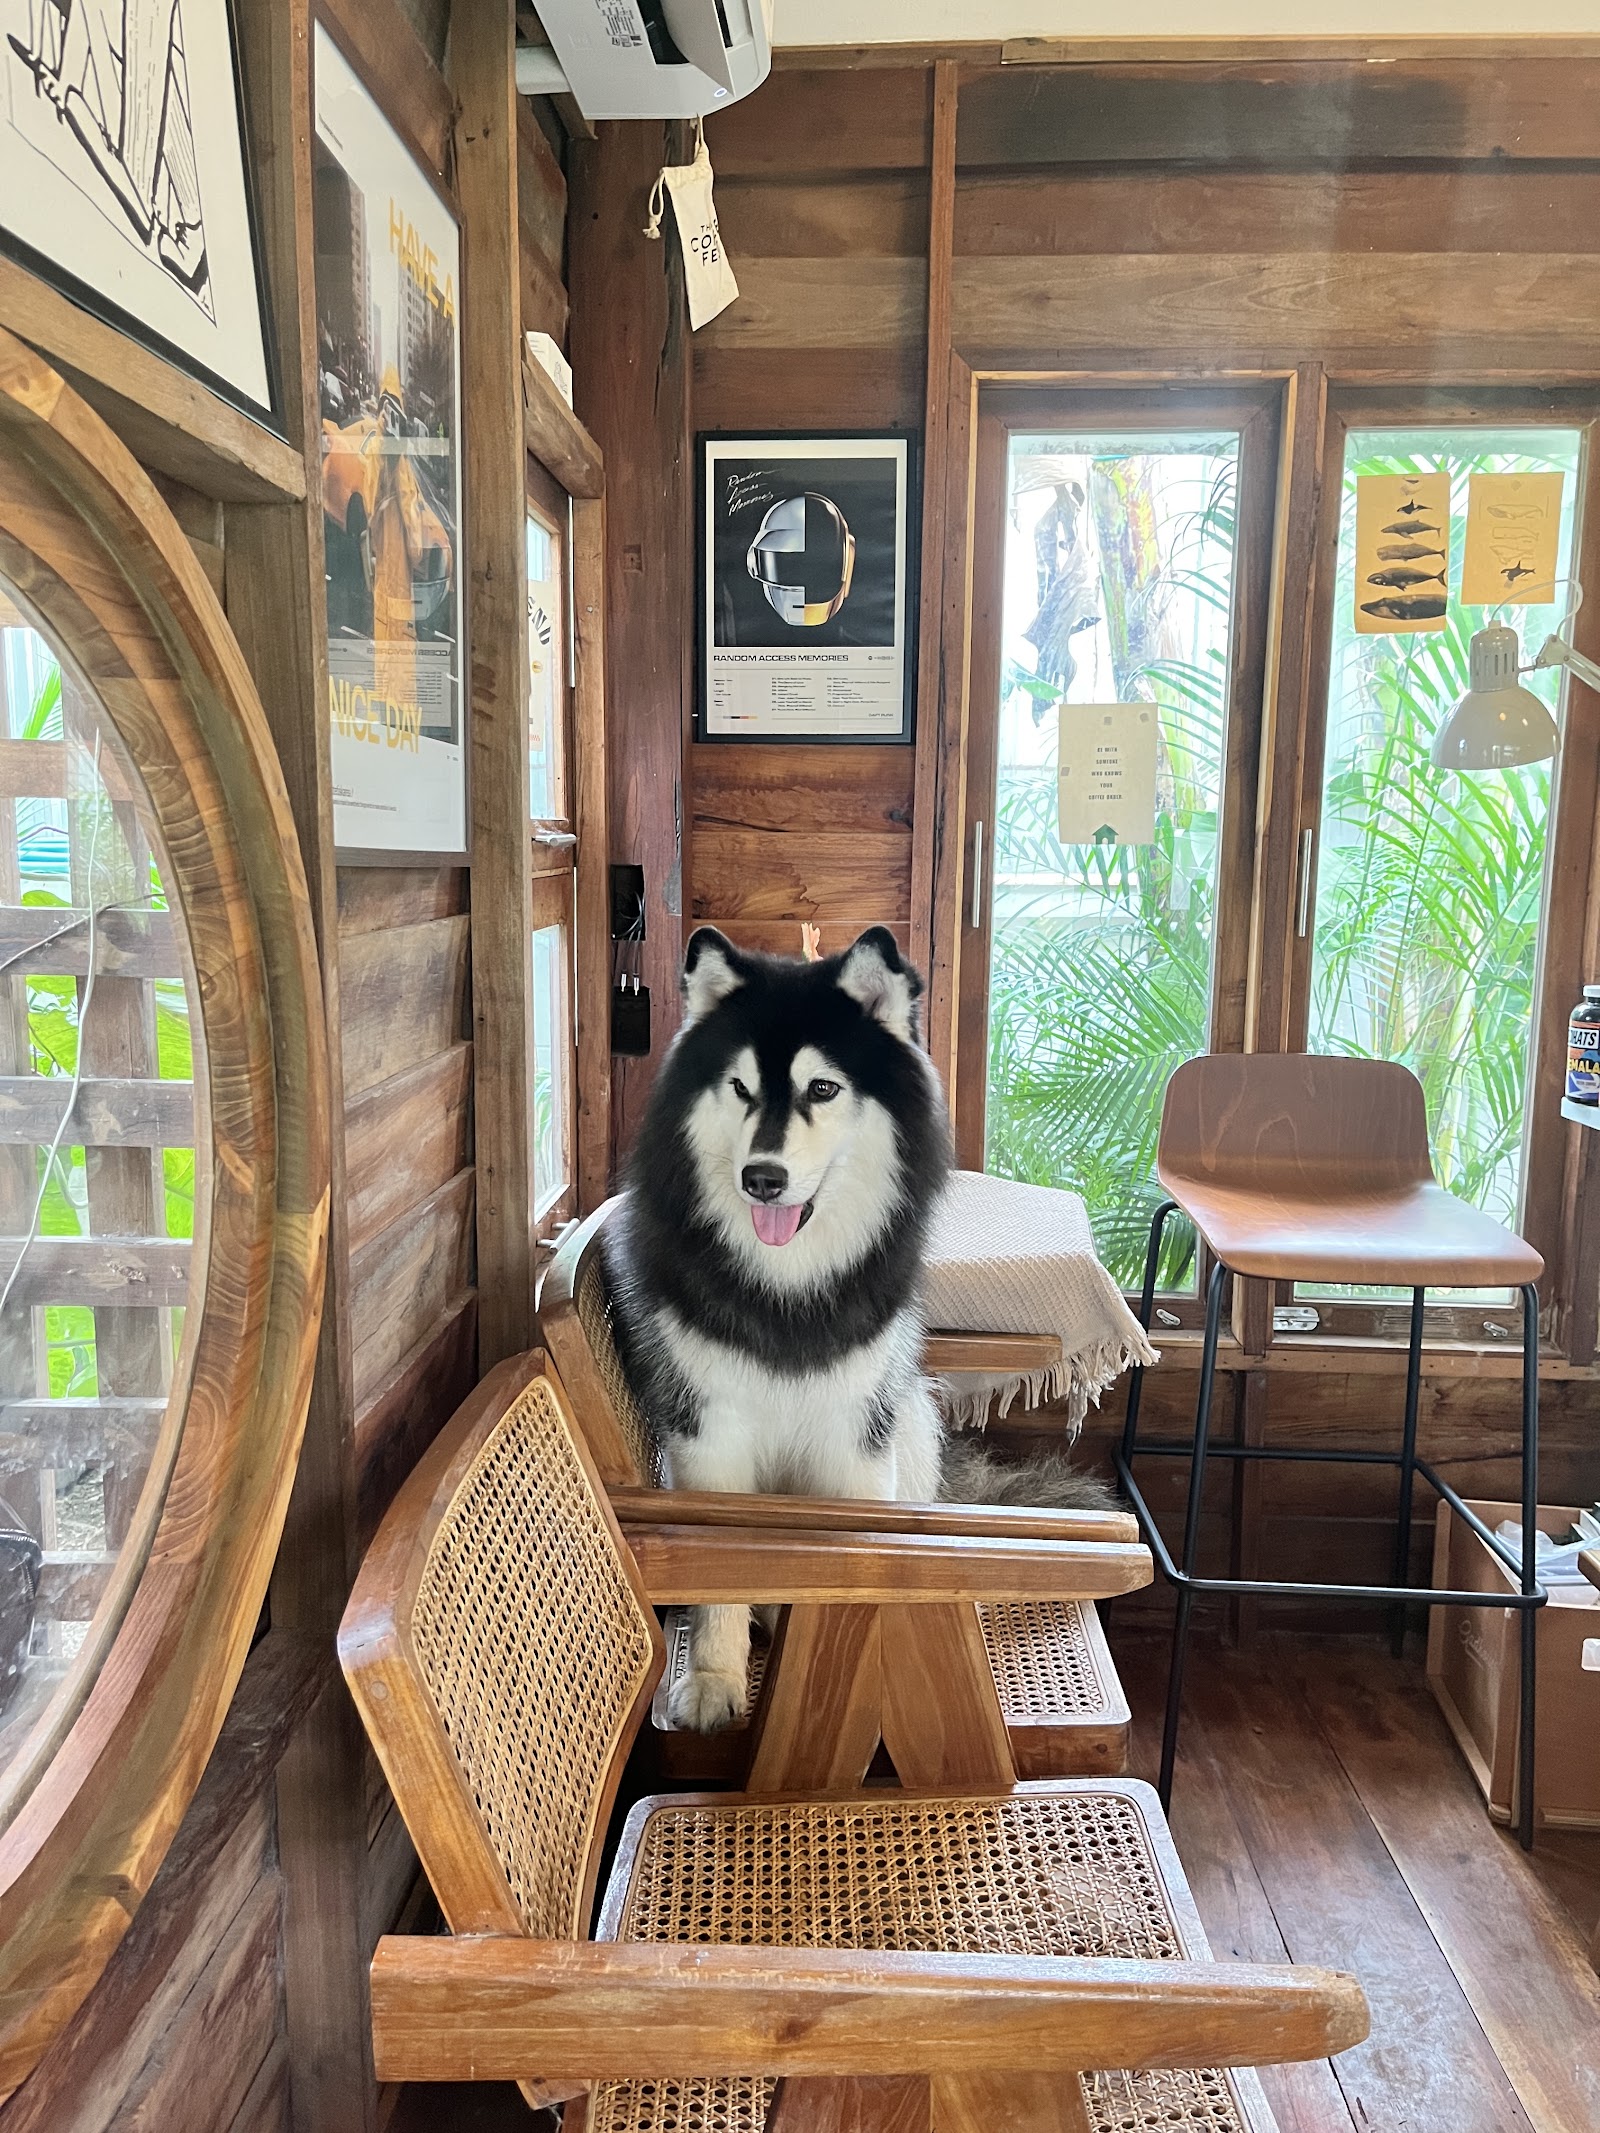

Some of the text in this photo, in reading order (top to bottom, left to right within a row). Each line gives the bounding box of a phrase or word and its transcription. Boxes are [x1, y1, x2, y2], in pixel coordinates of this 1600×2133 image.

[389, 197, 456, 328] HAVE A
[329, 675, 385, 745] NICE
[386, 697, 422, 753] DAY
